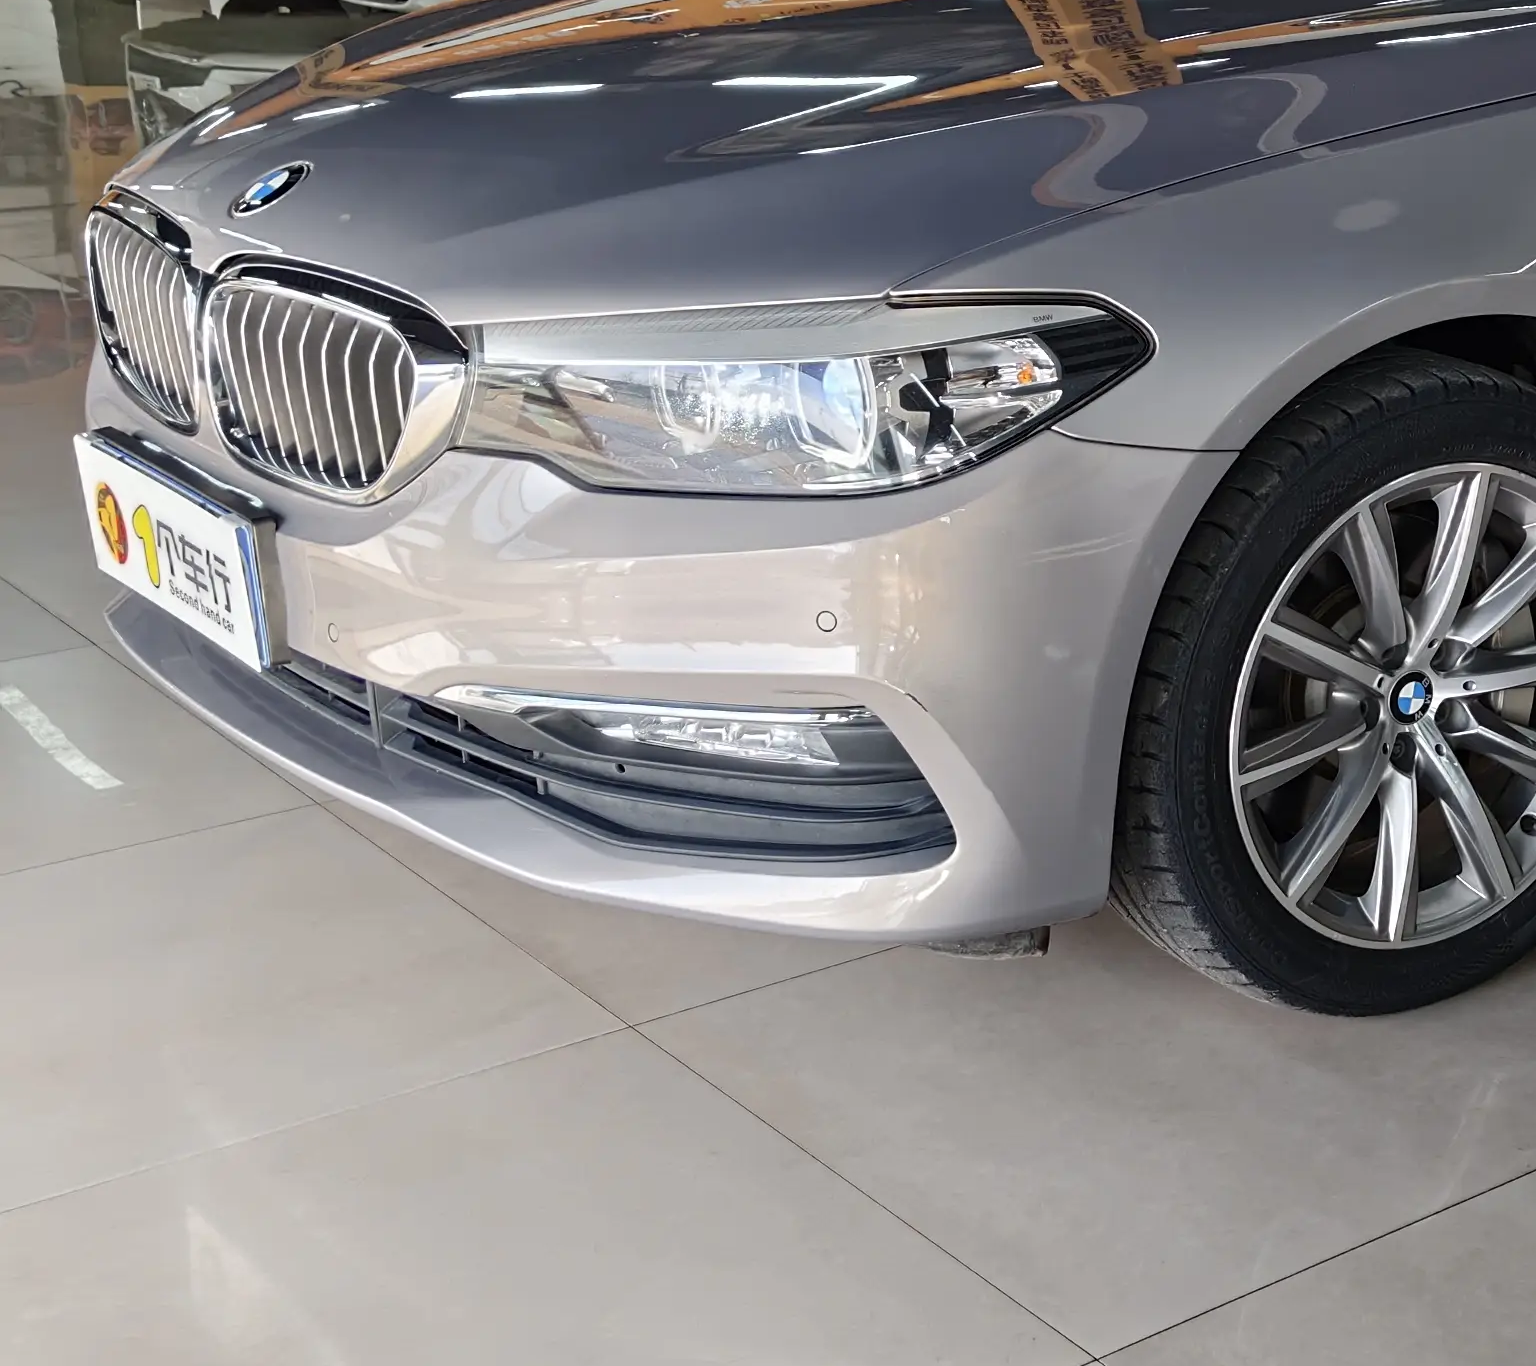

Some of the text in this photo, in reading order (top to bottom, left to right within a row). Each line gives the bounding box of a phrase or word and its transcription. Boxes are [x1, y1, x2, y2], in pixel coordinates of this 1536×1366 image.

[1032, 314, 1053, 323] BMW
[168, 578, 200, 608] Second
[1414, 676, 1432, 721] BMW
